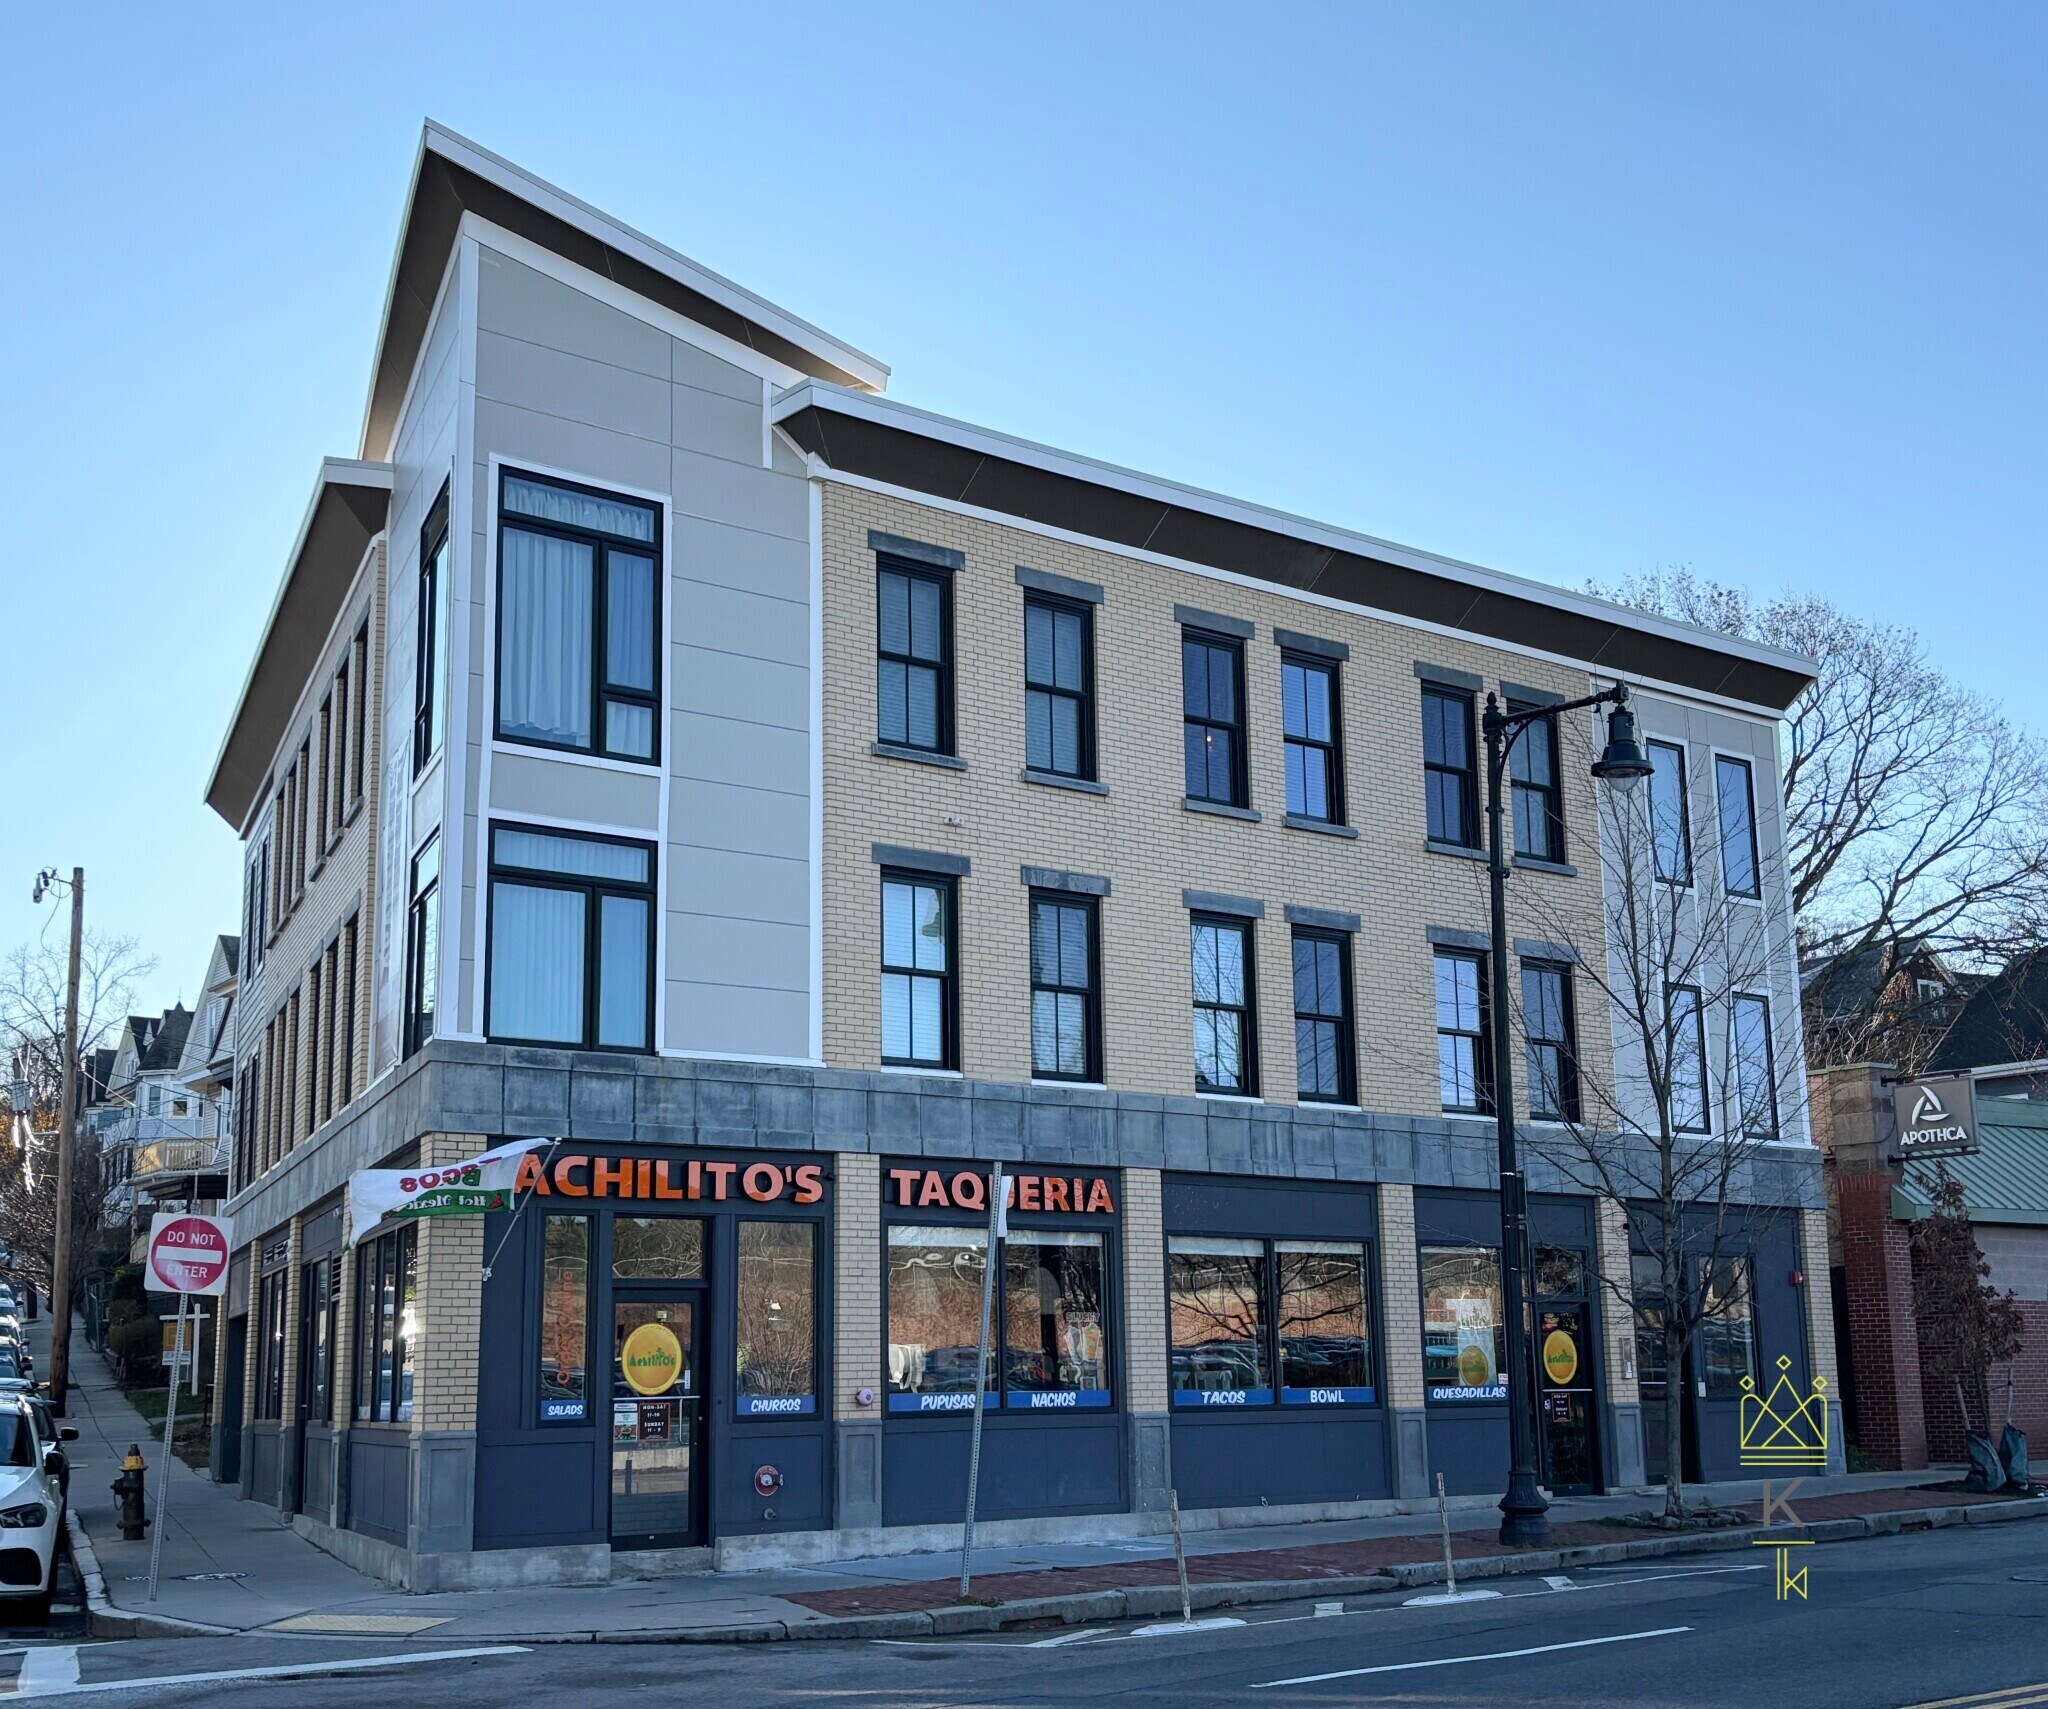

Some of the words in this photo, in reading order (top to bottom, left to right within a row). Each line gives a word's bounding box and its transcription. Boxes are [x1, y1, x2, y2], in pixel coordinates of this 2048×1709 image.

[1900, 1126, 1967, 1146] APOTHCA
[514, 1153, 824, 1204] ACHILITO'S
[167, 1231, 185, 1243] DO
[190, 1233, 216, 1246] NOT
[166, 1264, 208, 1278] ENTER
[1031, 1391, 1077, 1408] NACHOS
[1201, 1390, 1246, 1404] TACOS
[1310, 1390, 1345, 1403] BOWL
[1433, 1386, 1507, 1399] QUESADILLAS
[750, 1398, 801, 1412] CHURROS
[921, 1393, 976, 1410] PUPUSAS
[547, 1404, 583, 1416] SALADS
